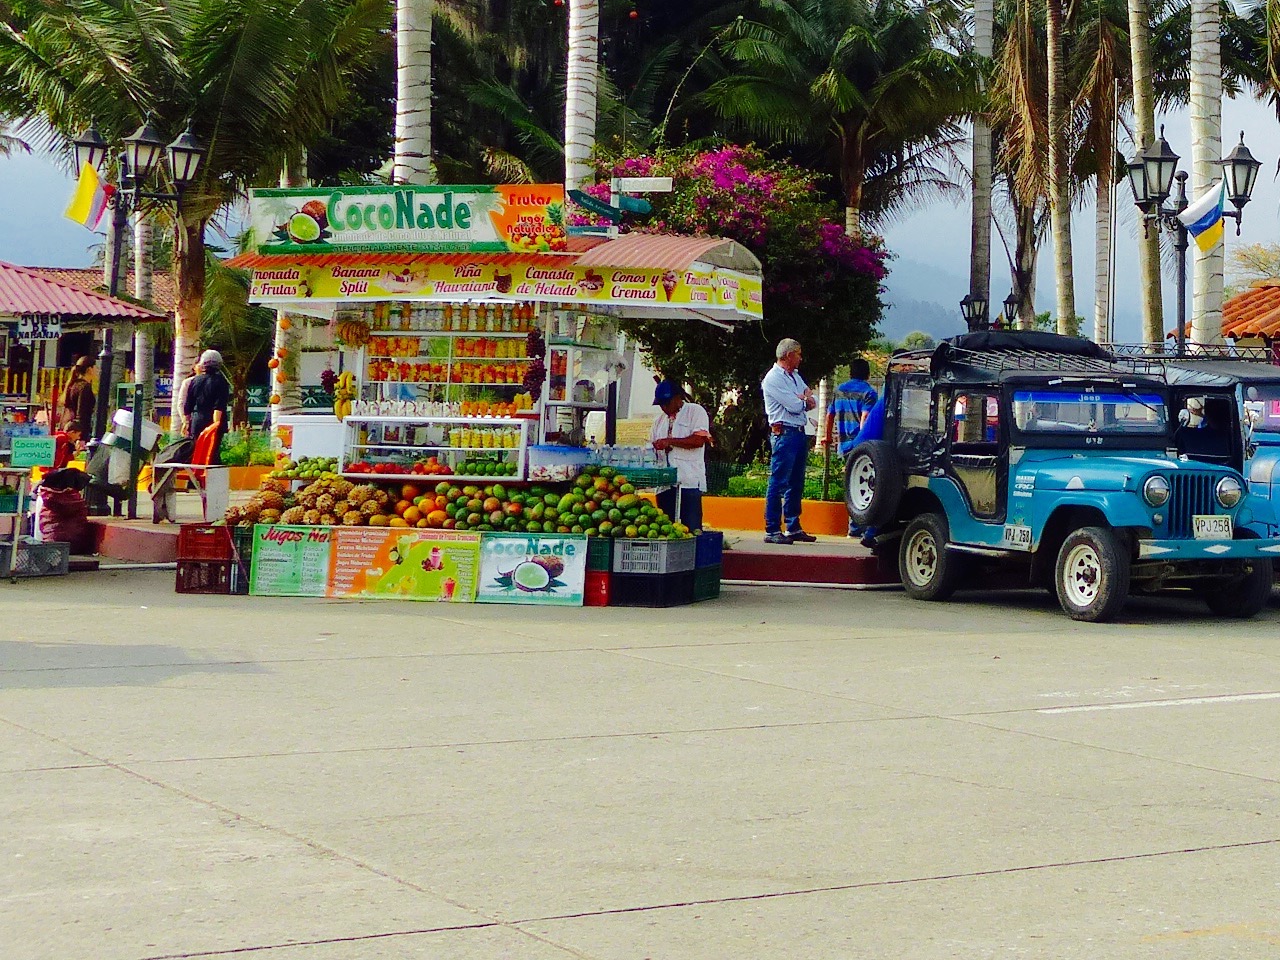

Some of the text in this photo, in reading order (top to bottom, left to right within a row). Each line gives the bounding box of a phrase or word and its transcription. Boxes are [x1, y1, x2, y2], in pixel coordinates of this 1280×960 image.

[508, 194, 551, 206] Frutas
[327, 190, 471, 231] CocoNade
[516, 214, 545, 226] Jugos
[507, 225, 556, 234] Naturales
[331, 265, 380, 278] Banana
[454, 265, 481, 278] Piña
[525, 266, 575, 280] Canasta
[612, 271, 659, 286] Conos y
[260, 283, 297, 295] Frutas
[340, 280, 368, 296] Split
[435, 281, 496, 293] Hawaiana
[516, 283, 577, 296] de Helado
[611, 285, 656, 299] Cremas
[1078, 394, 1100, 402] Jeep
[14, 440, 51, 449] Coconut
[261, 526, 305, 546] Jugos
[483, 537, 576, 556] CocoNade
